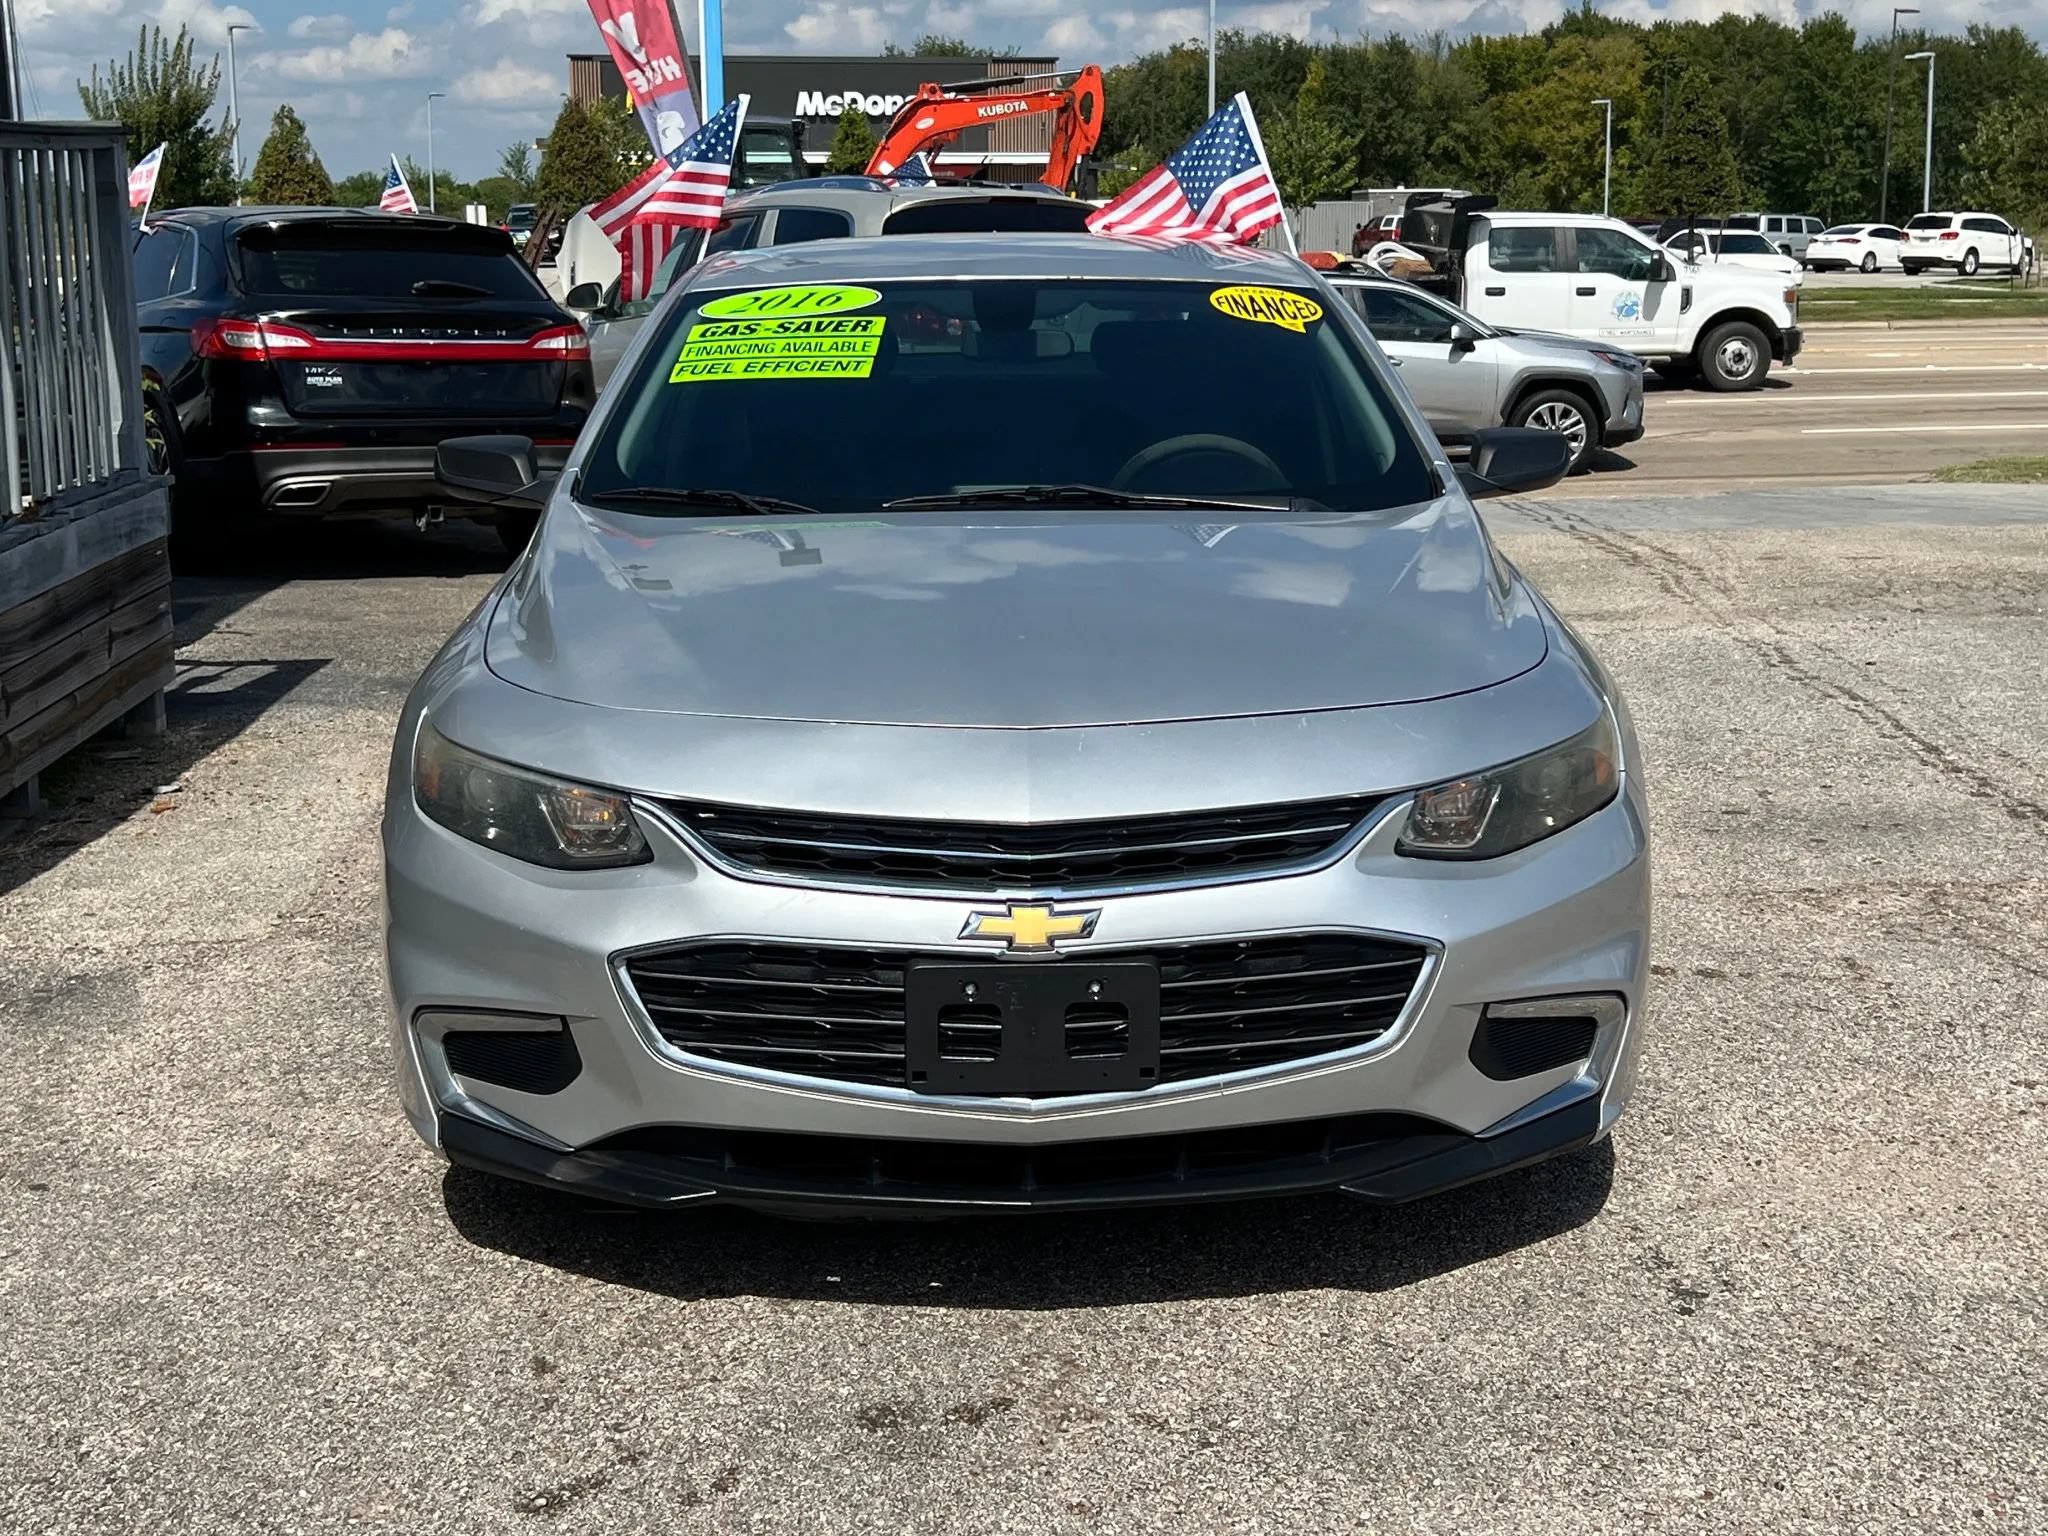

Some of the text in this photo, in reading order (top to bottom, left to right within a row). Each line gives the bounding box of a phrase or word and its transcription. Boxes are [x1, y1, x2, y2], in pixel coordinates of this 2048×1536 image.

[977, 100, 1029, 118] KUBOTA
[727, 290, 849, 314] 2016
[1215, 294, 1318, 320] FINANCED
[343, 327, 507, 338] LINCOLN
[698, 319, 875, 338] GAS-SAVER
[685, 340, 873, 358] FINANCING AVAILABLE
[675, 360, 868, 377] FUEL EFFICIENT
